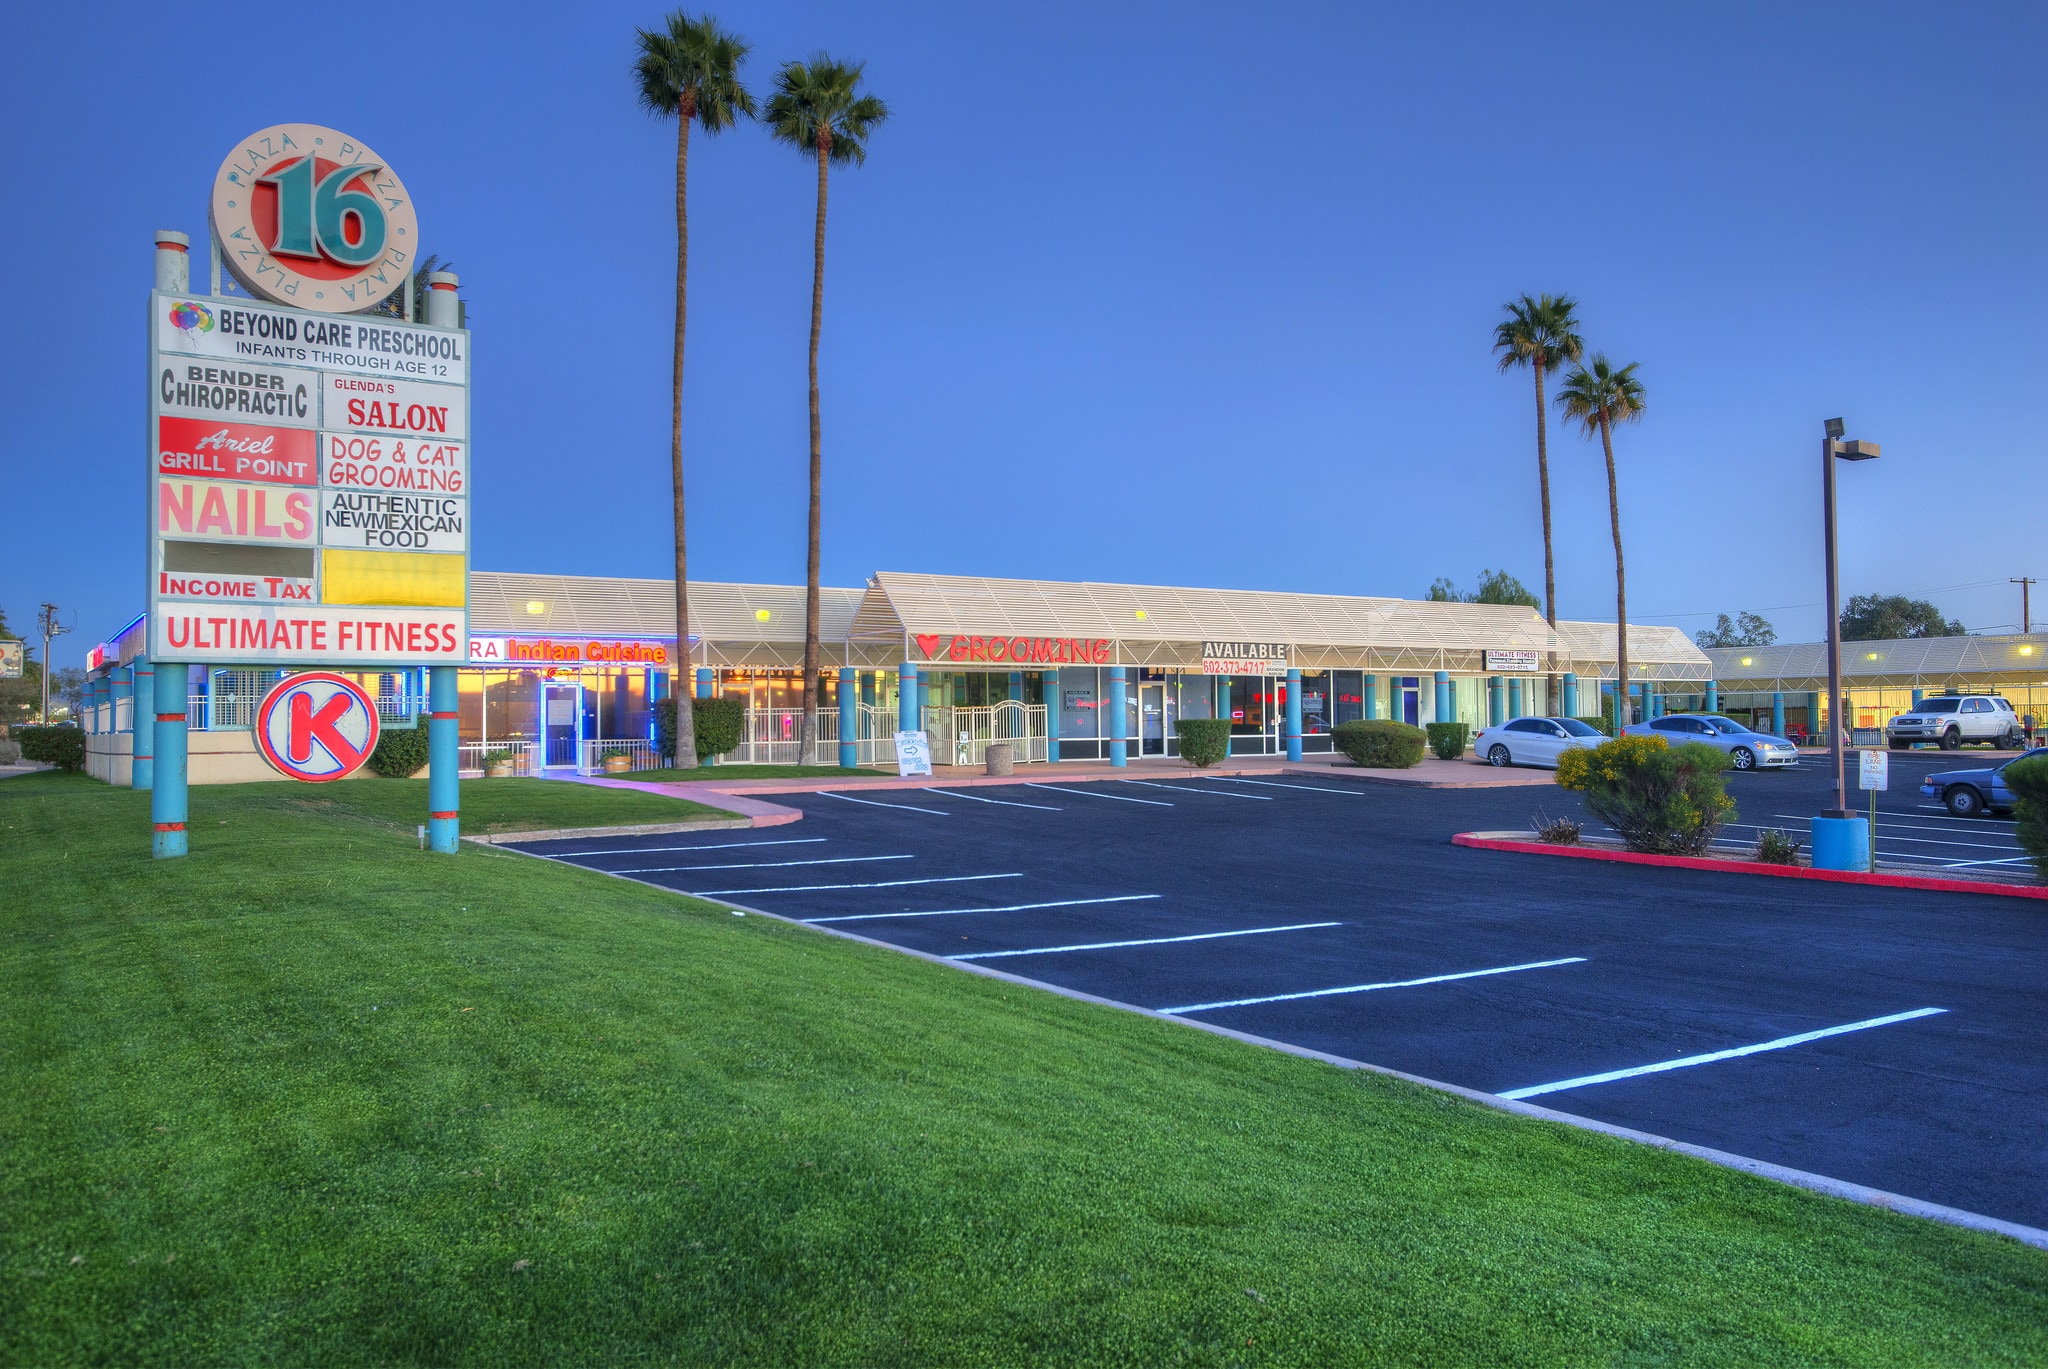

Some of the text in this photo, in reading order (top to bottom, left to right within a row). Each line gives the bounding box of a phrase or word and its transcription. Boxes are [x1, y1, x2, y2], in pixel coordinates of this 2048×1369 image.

[227, 133, 299, 188] PLAZA
[254, 150, 389, 268] 16
[230, 226, 300, 297] PLAZA
[340, 247, 406, 302] PLAZA
[220, 309, 461, 361] BEYOND CARE PRESCHOOL
[236, 341, 447, 377] INFANTS THROUGH AGE 12
[161, 368, 308, 418] CHIROPRACTIC
[188, 366, 284, 390] BENDER
[335, 379, 395, 394] GLENDA'S
[347, 398, 448, 433] SALON
[195, 429, 274, 454] Ariel
[331, 436, 460, 467] DOG & CAT
[159, 451, 307, 478] GRILL POINT
[329, 462, 462, 492] GROOMING
[159, 482, 315, 540] NAILS
[332, 493, 457, 515] AUTHENTIC
[325, 510, 462, 533] NEWMEXICAN
[365, 529, 429, 548] FOOD
[168, 617, 457, 652] ULTIMATE FITNESS
[950, 635, 1110, 663] GROOMING
[509, 639, 579, 661] Indian
[586, 641, 666, 664] Cuisine
[1204, 642, 1285, 658] AVAILABLE
[1203, 660, 1264, 674] 602-373-4717
